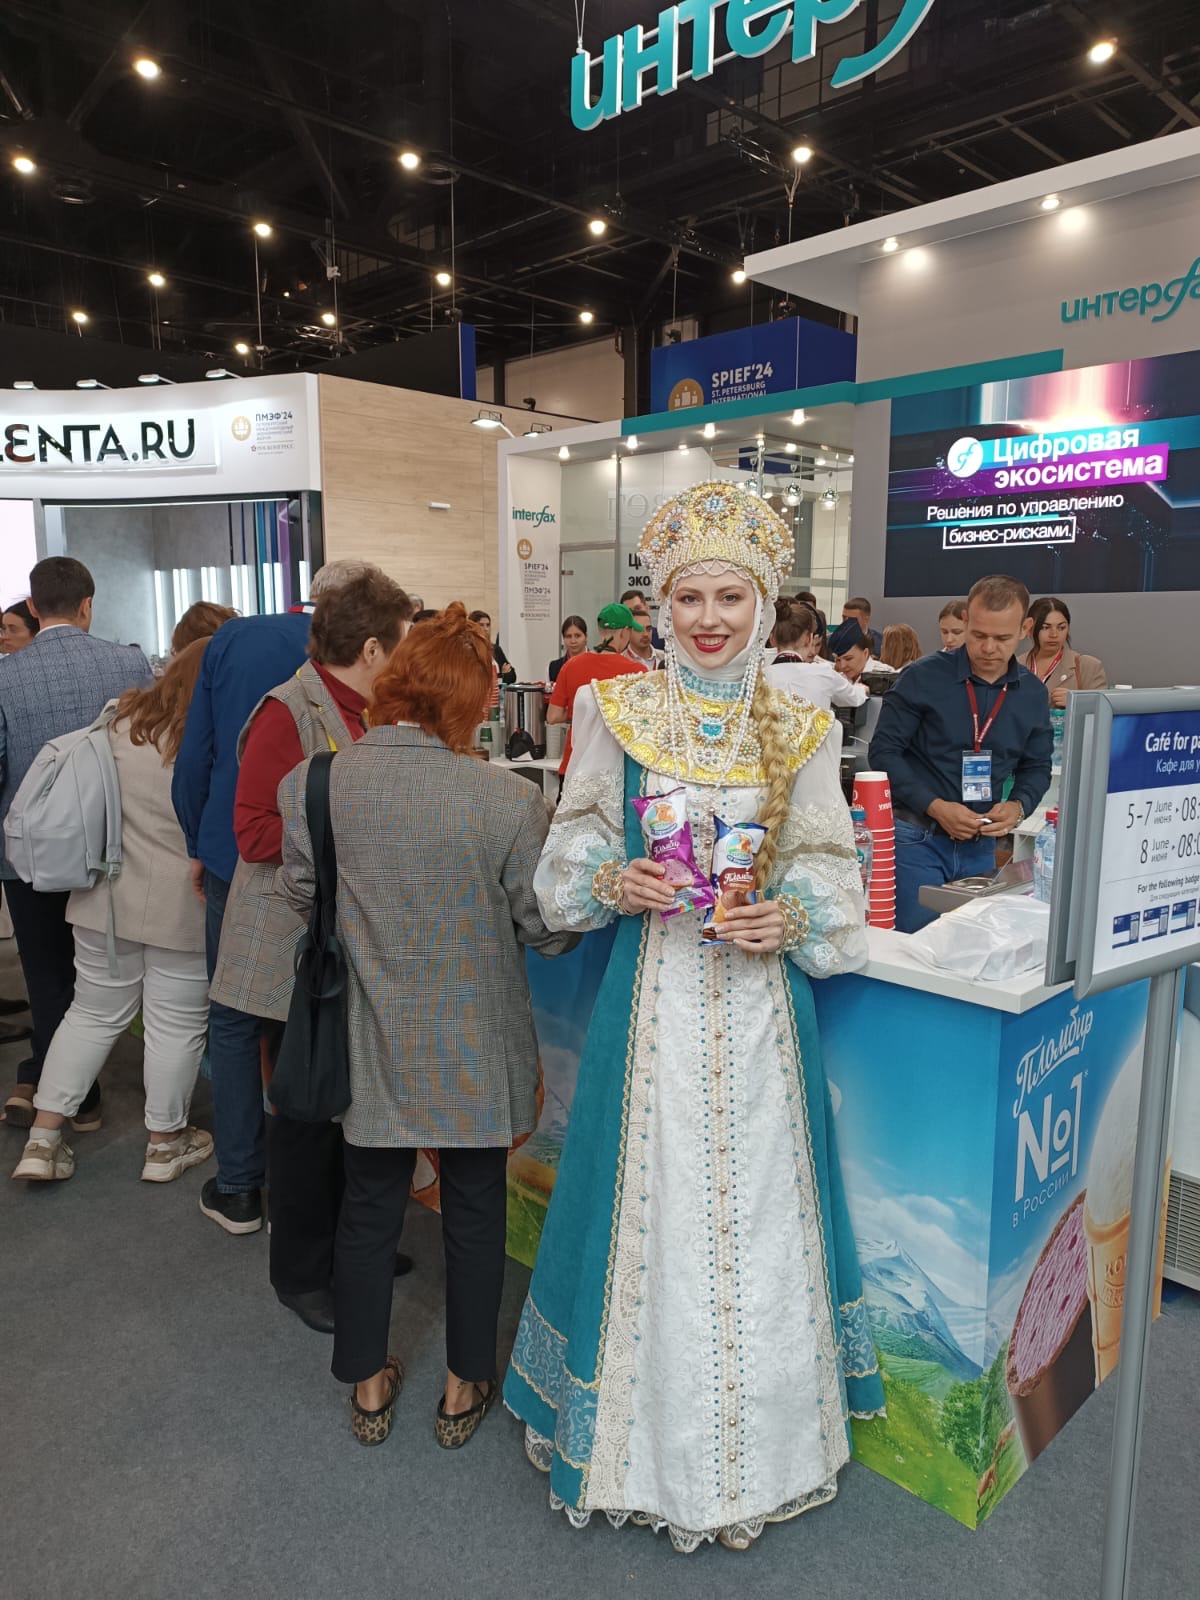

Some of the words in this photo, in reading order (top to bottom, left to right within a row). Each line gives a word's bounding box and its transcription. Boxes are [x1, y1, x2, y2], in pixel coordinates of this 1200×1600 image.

[711, 390, 721, 398] ST.
[722, 381, 766, 397] PETERSBURG
[0, 418, 196, 463] ENTA.RU
[993, 429, 1140, 466] Цифровая
[994, 454, 1163, 489] экосистема
[512, 505, 556, 528] interfax
[927, 503, 992, 521] Решения
[997, 503, 1016, 519] по
[1020, 494, 1124, 519] управлению
[949, 524, 1072, 544] бизнес-рисками.
[1145, 731, 1171, 753] Café
[1173, 731, 1190, 751] for
[1156, 758, 1178, 775] Кафе
[1178, 759, 1195, 773] для
[1154, 800, 1173, 813] June
[1140, 839, 1148, 864] 8
[1152, 839, 1170, 851] June
[1137, 884, 1148, 893] For
[1148, 881, 1157, 891] the
[1158, 877, 1184, 889] following
[1012, 1004, 1093, 1119] Пломбир
